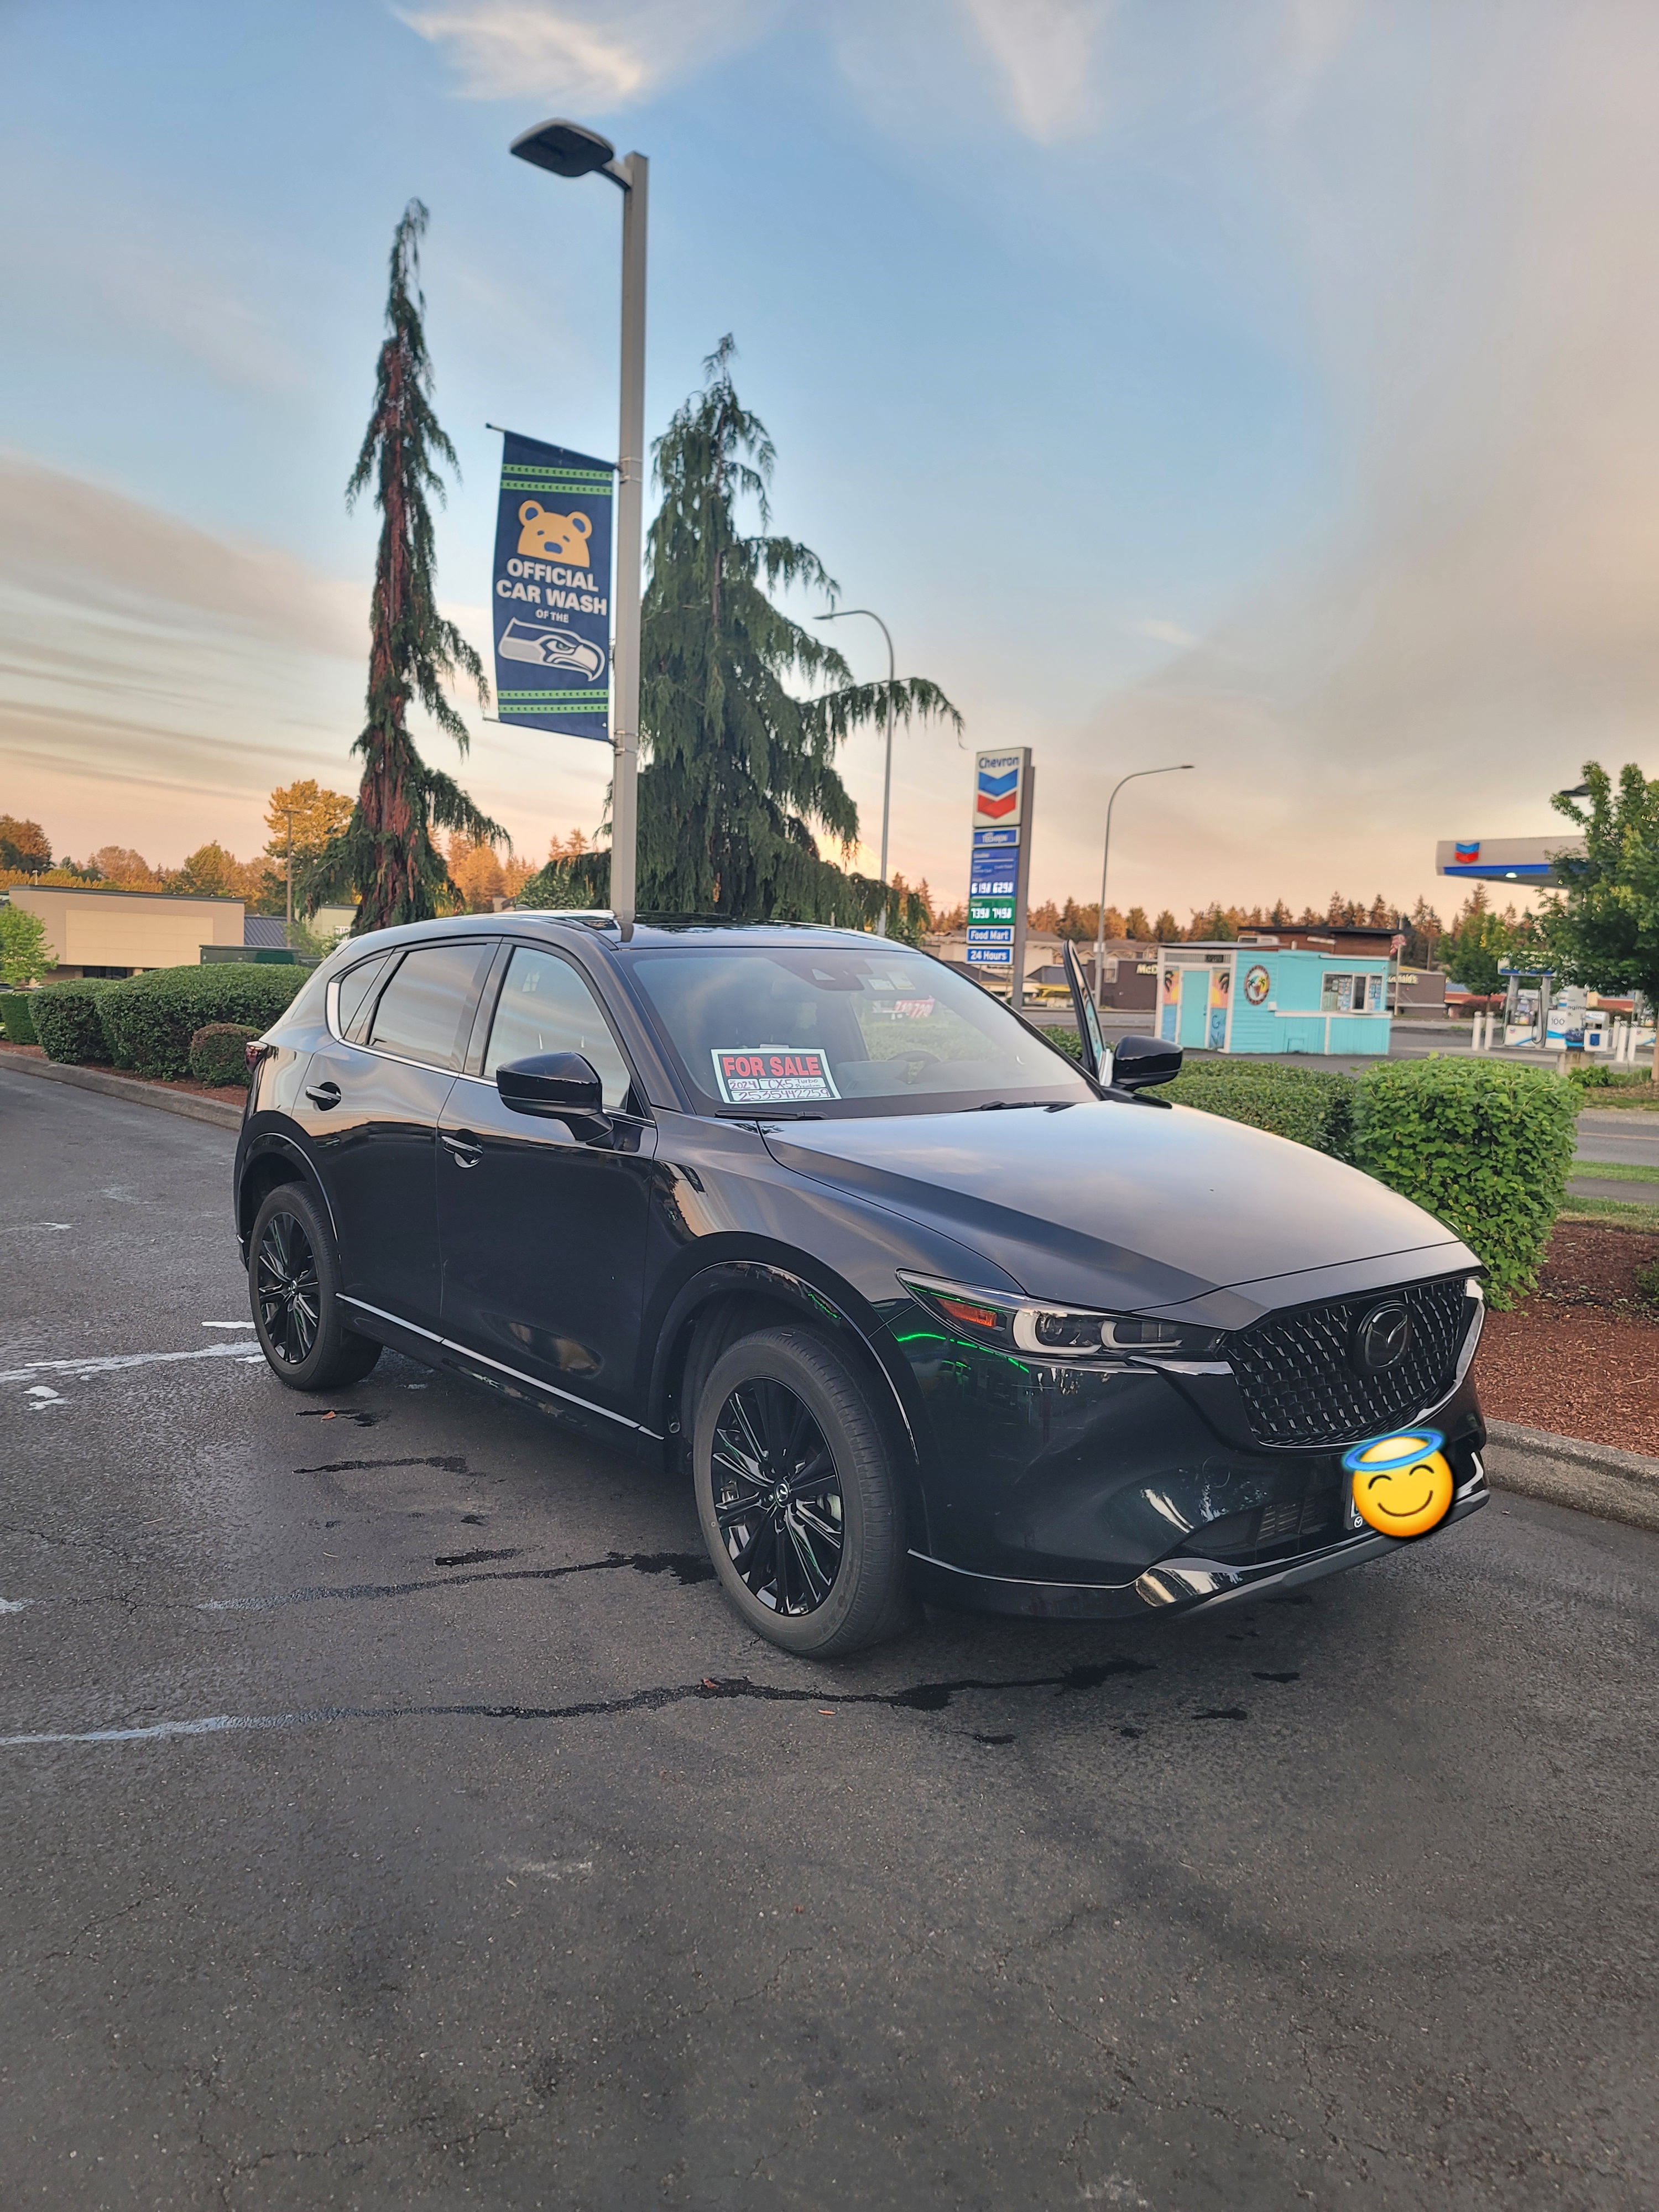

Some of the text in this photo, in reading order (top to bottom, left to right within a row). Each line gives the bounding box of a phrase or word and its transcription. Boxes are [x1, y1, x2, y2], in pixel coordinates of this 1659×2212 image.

[507, 558, 598, 592] OFFICIAL
[496, 580, 607, 616] CAR WASH
[535, 609, 569, 623] OF THE
[979, 757, 1019, 769] Chevron
[971, 930, 1009, 940] Food Mart
[971, 950, 1007, 960] 24 Hours
[1551, 1017, 1565, 1025] 100
[722, 1056, 822, 1077] FOR SALE
[738, 1088, 830, 1101] 2535442259
